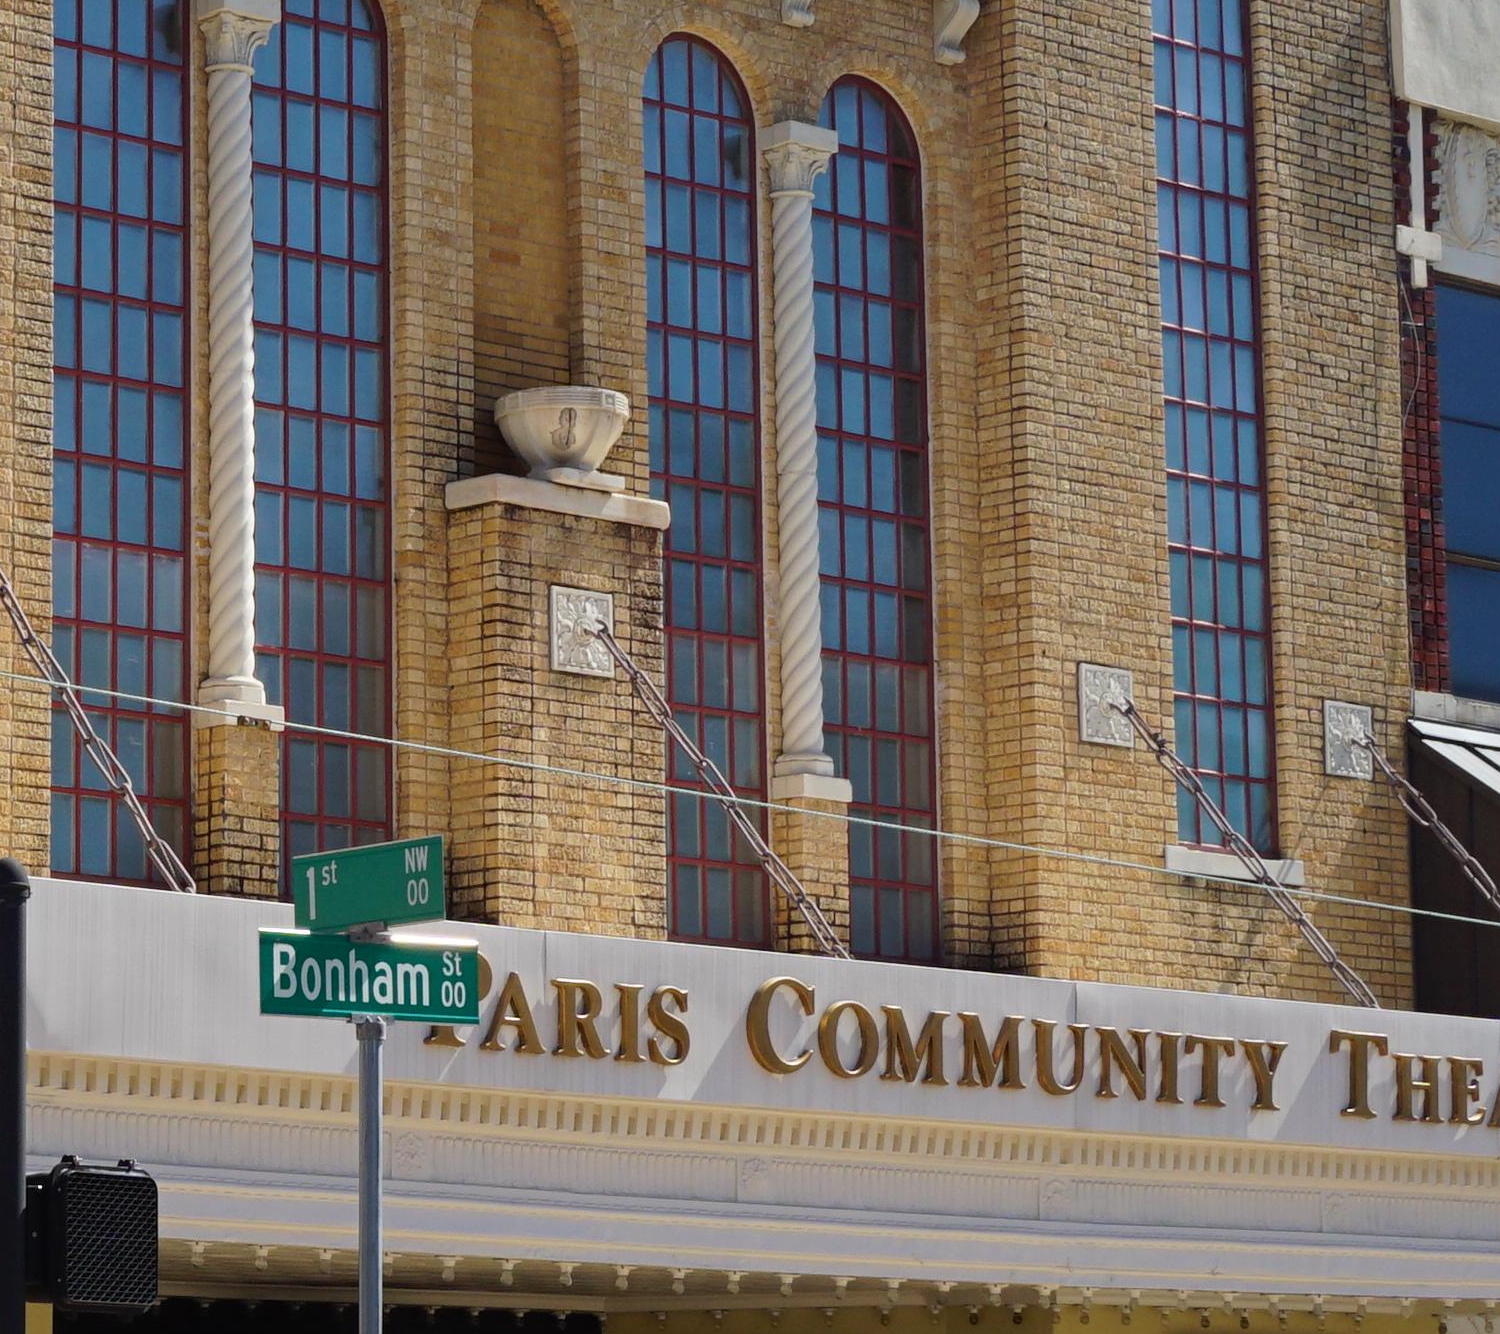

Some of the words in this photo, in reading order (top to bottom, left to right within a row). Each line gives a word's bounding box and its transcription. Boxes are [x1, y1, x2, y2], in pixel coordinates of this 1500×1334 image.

[404, 846, 429, 875] NW
[305, 860, 338, 921] 1st
[406, 880, 430, 907] 00
[273, 942, 431, 1008] Bonham
[442, 950, 463, 977] St
[441, 980, 467, 1009] 00
[746, 974, 1288, 1112] COMMUNITY
